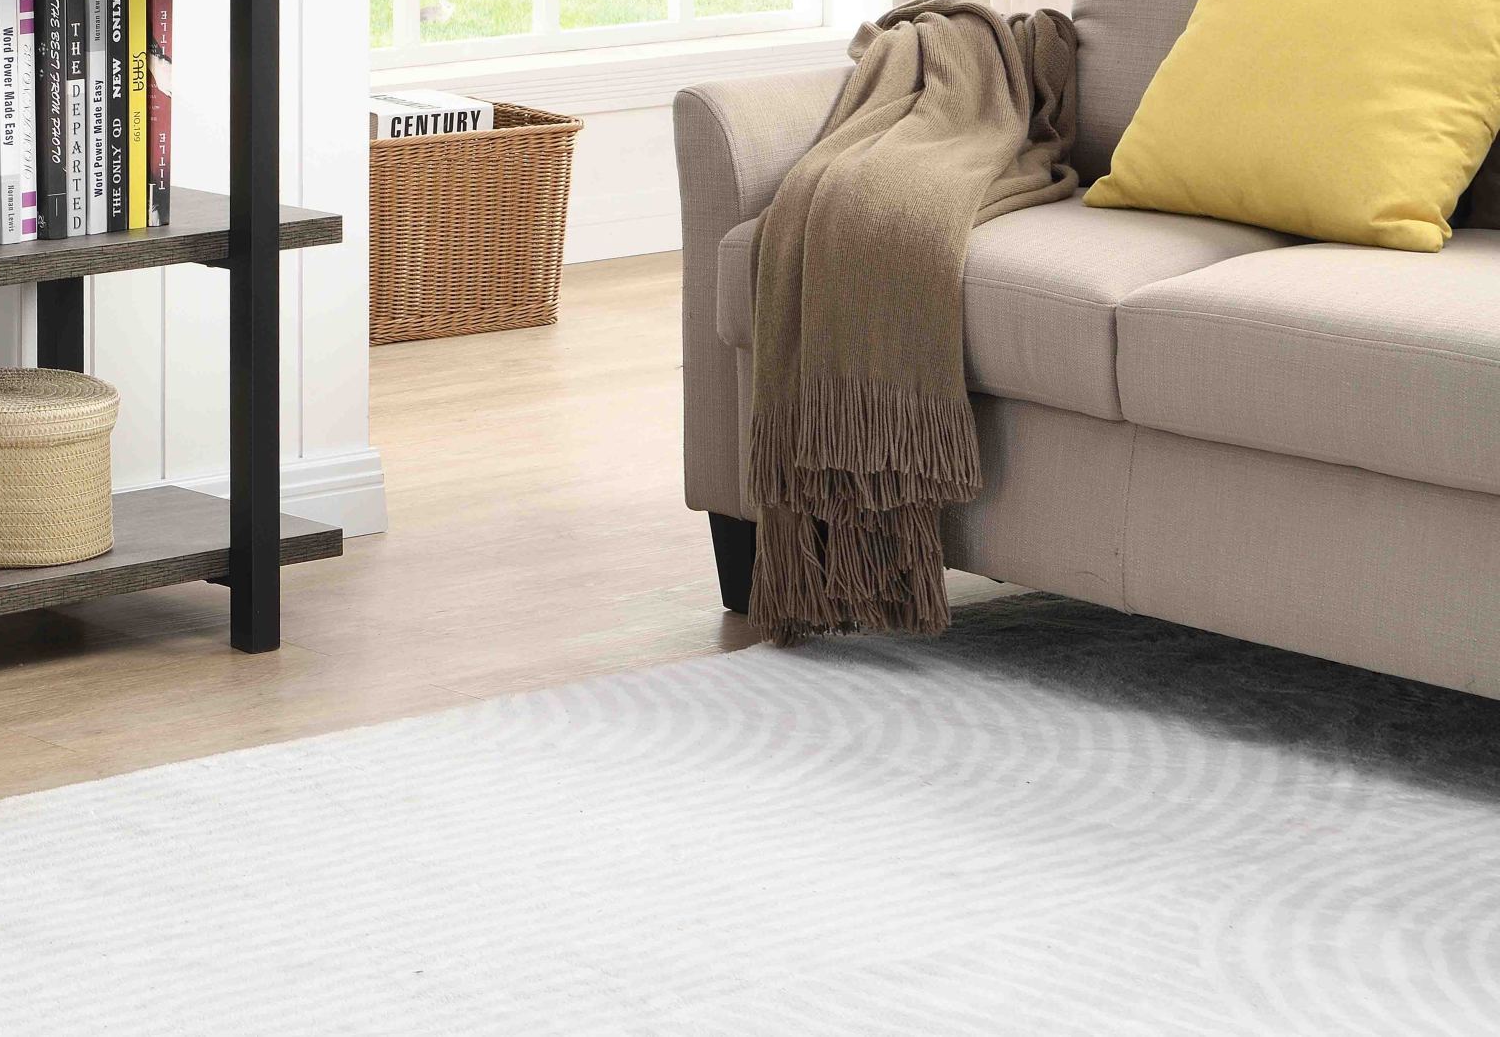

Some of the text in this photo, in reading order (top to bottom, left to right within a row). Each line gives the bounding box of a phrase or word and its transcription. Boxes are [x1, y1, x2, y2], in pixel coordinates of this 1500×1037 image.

[50, 31, 60, 69] BEST
[2, 26, 16, 146] Word Power Made Easy
[49, 72, 61, 114] FROM
[112, 57, 122, 98] NEW
[131, 51, 147, 142] SARA NO.199
[51, 117, 61, 164] PHOTO
[71, 22, 82, 230] THE DEPARTED
[93, 79, 104, 197] Word Power Made Easy
[113, 118, 123, 138] QD
[390, 110, 481, 138] CENTURY
[111, 144, 122, 184] ONLY
[158, 133, 166, 190] TITLE
[7, 185, 15, 211] Norman
[112, 187, 122, 217] THE
